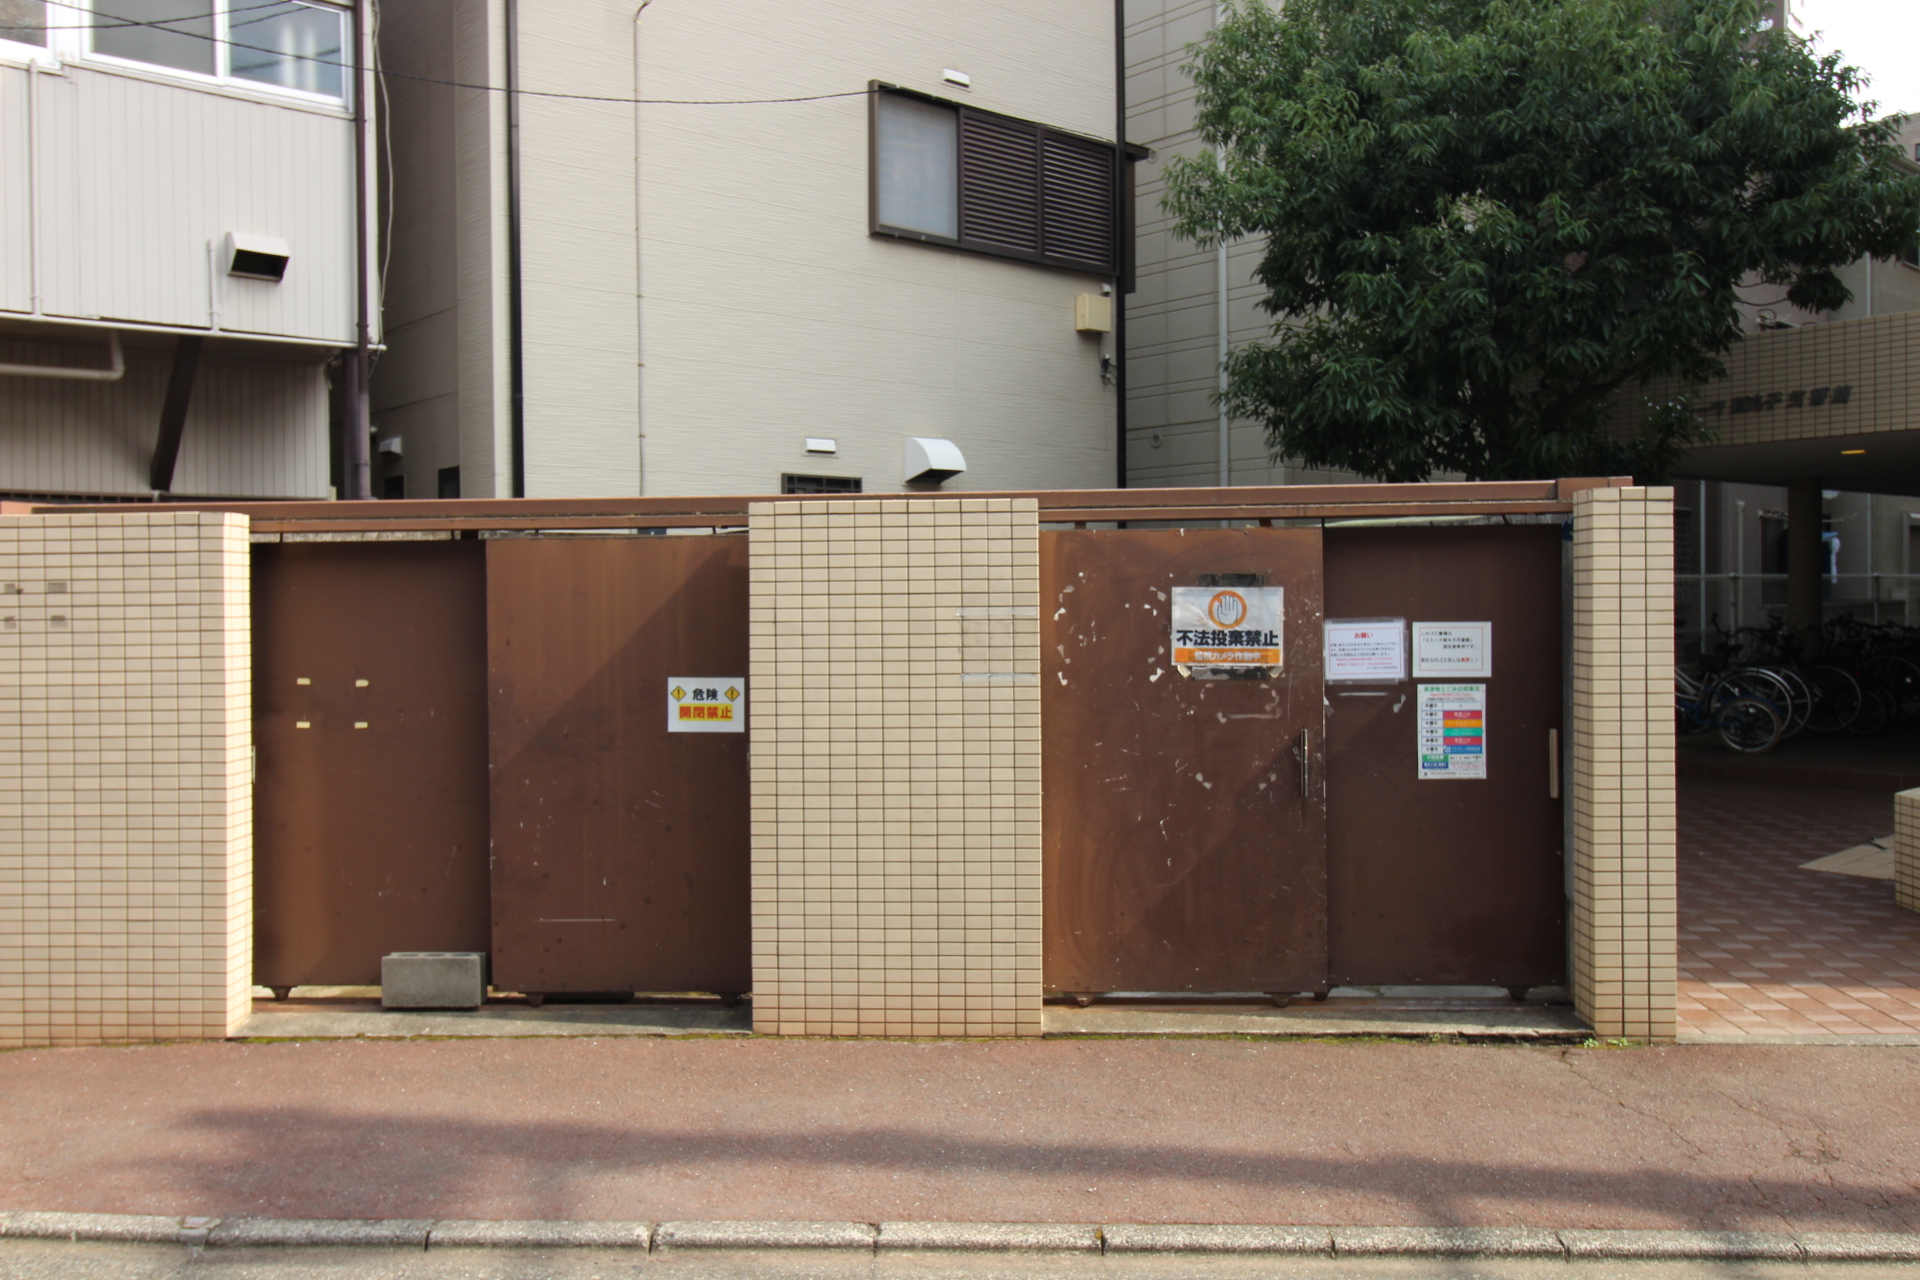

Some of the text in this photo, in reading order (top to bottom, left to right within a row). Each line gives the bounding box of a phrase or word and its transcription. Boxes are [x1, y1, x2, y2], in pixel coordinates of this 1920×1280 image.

[1176, 629, 1279, 647] 不法投棄禁止
[692, 688, 719, 701] 危険
[679, 706, 733, 719] 開閉禁止
